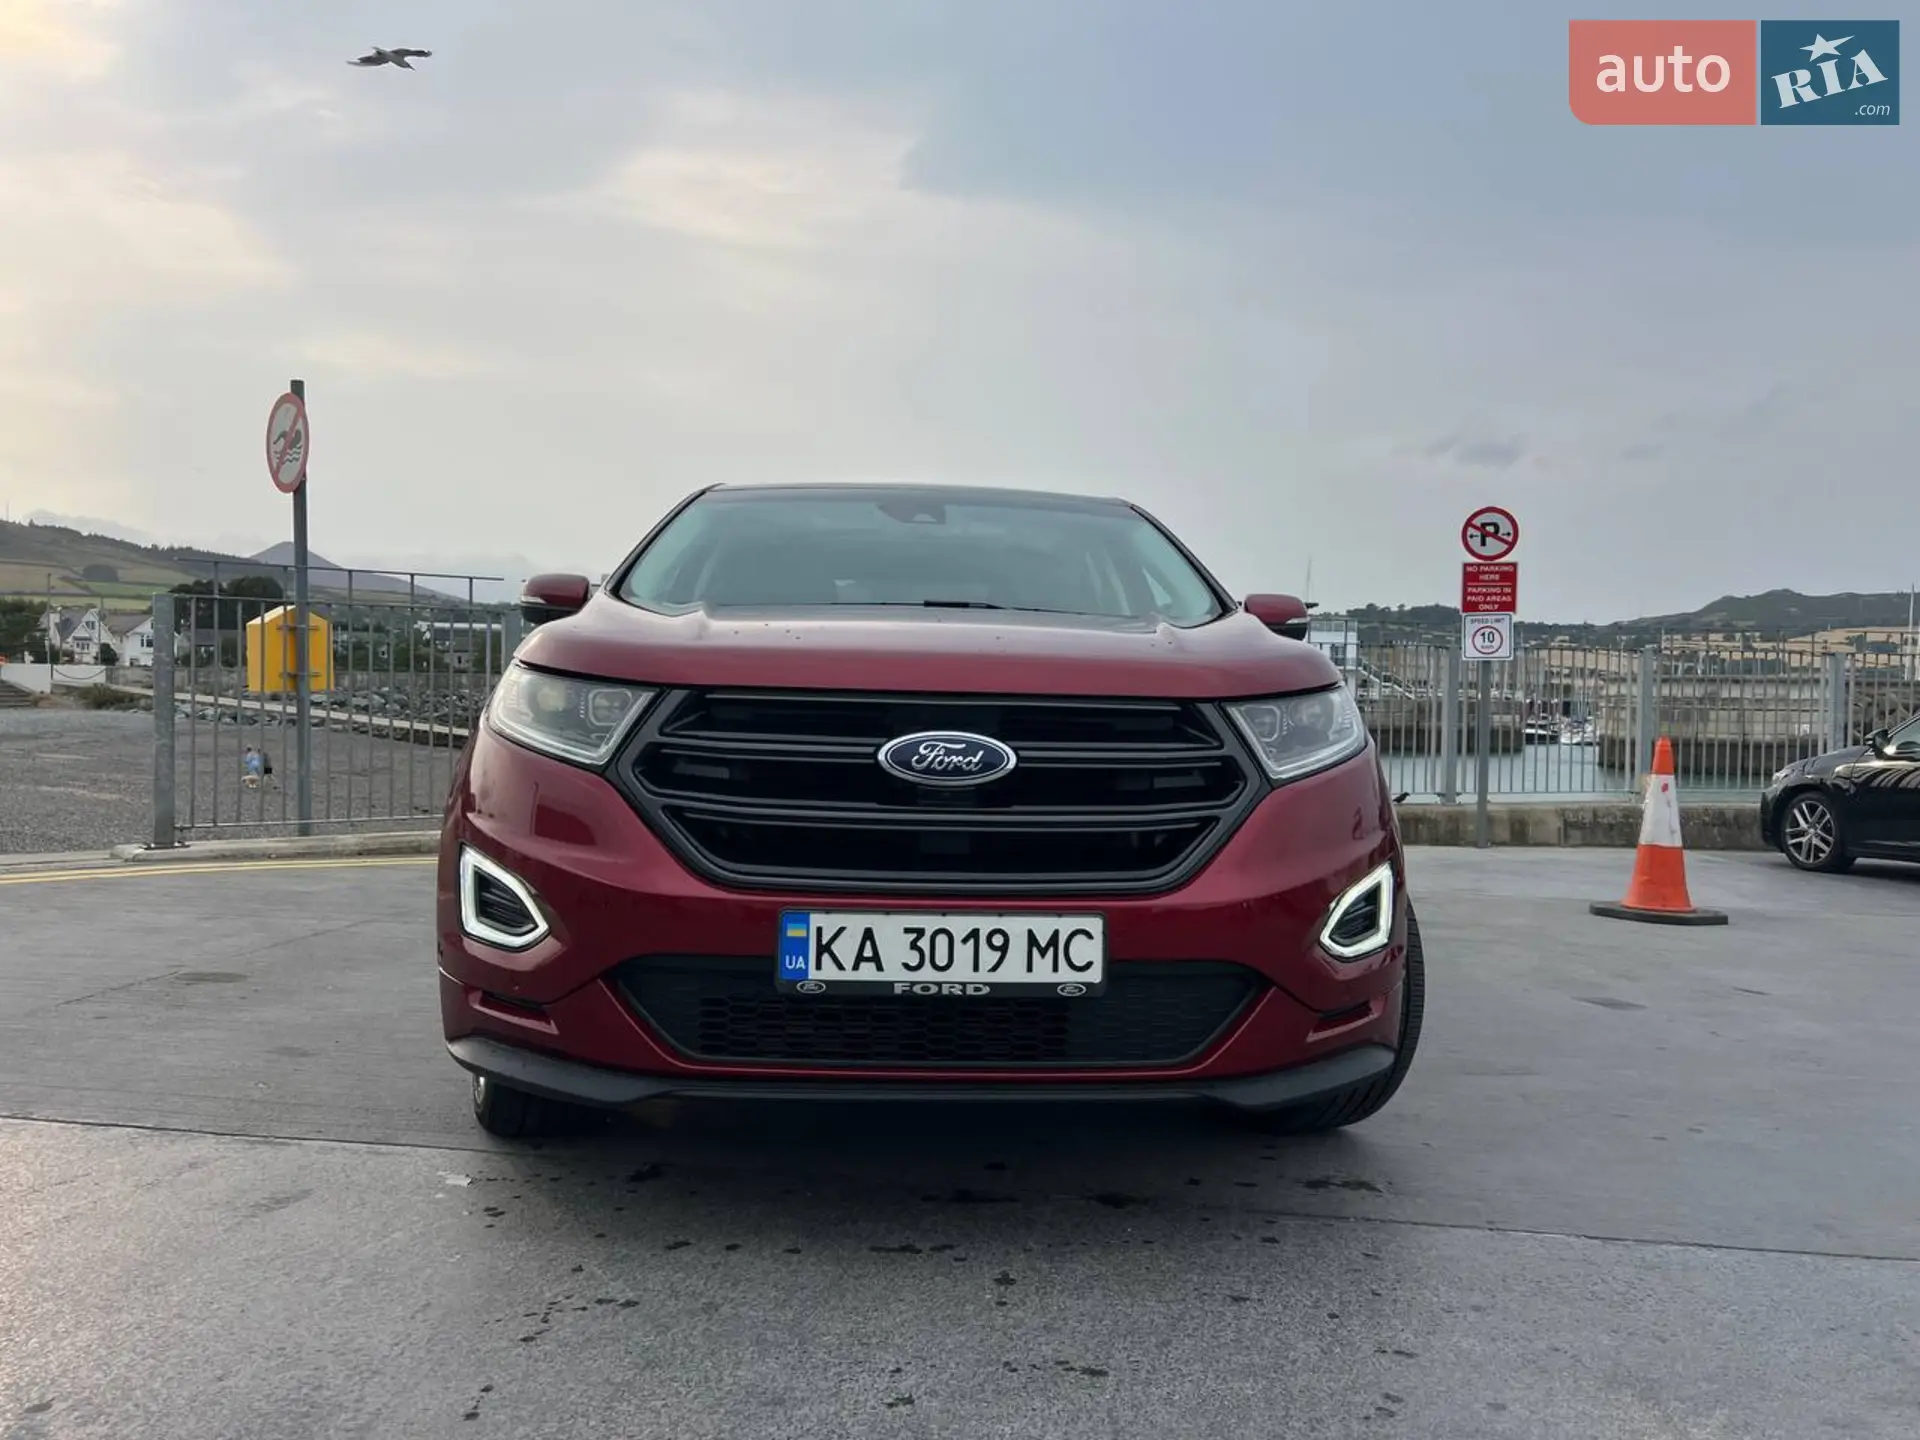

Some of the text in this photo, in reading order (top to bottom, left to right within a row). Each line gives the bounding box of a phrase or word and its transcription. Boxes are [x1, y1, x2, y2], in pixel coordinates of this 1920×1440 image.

[1480, 631, 1495, 643] 10
[911, 741, 984, 771] Ford
[814, 926, 1095, 973] KA 3019 MC
[785, 955, 806, 970] UA
[893, 983, 991, 996] FORD
